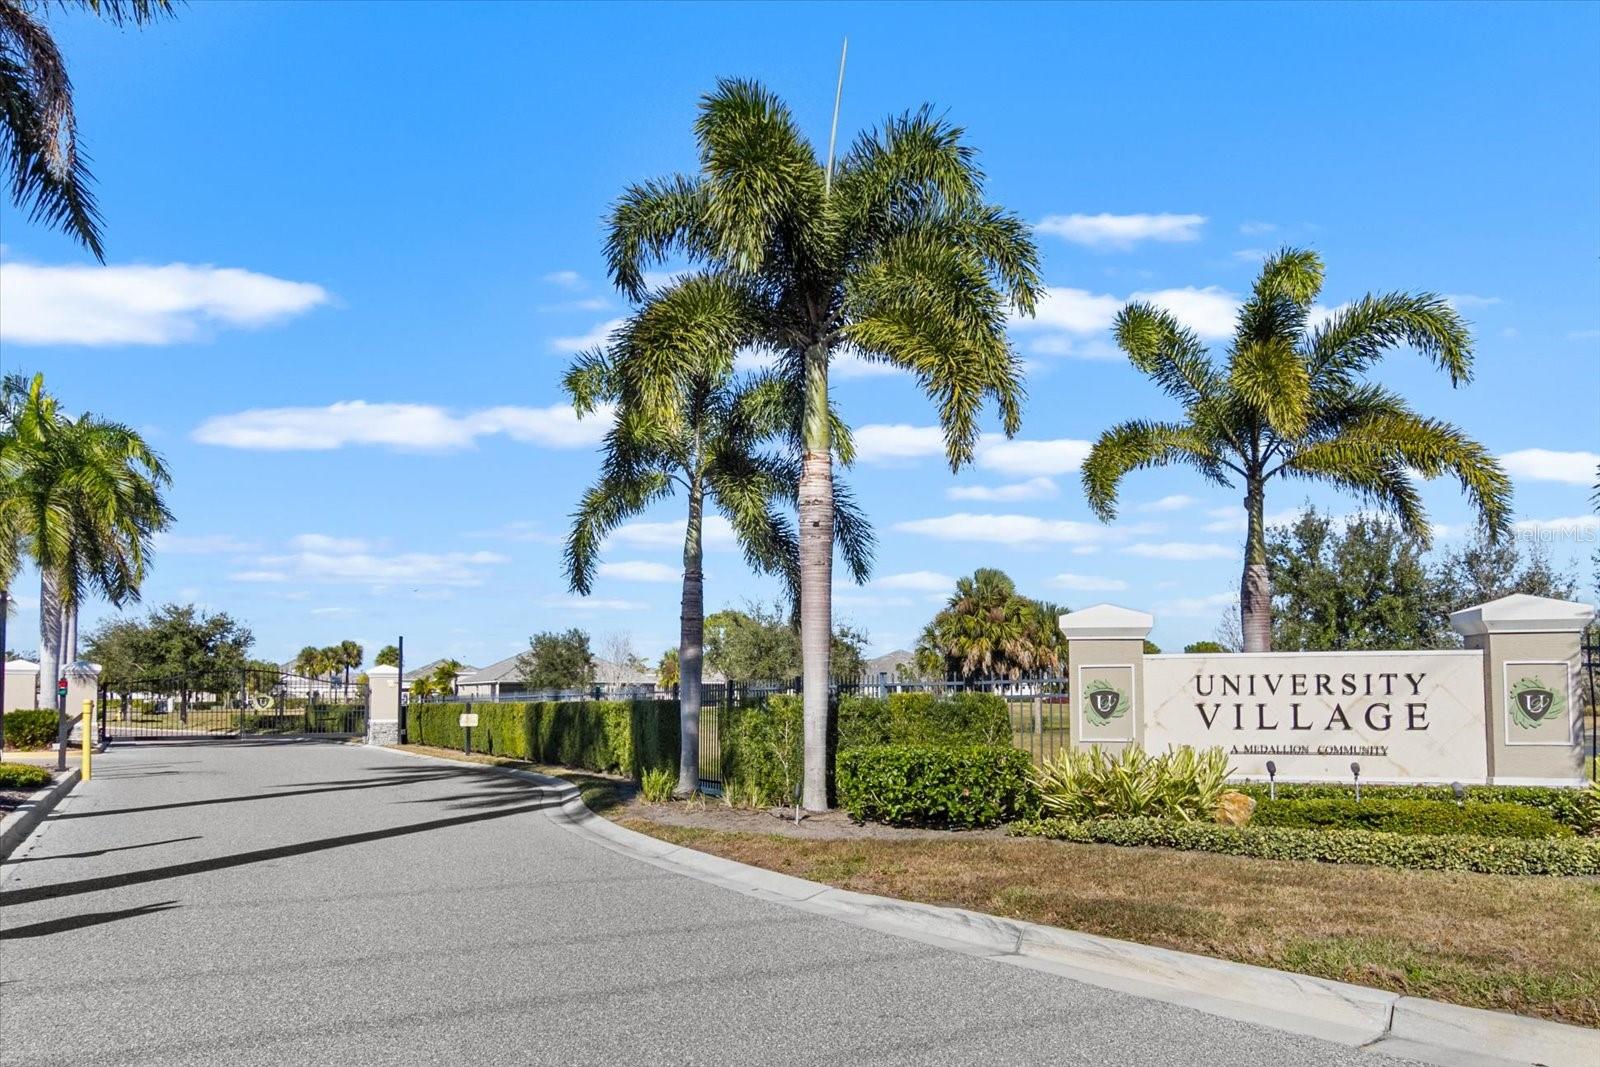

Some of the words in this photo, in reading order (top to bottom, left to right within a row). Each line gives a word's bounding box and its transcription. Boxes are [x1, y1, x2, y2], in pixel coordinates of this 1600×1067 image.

[1196, 673, 1427, 696] UNIVERSITY
[1195, 702, 1430, 731] VILLAGE
[1230, 745, 1238, 755] A
[1243, 745, 1310, 755] MEDALLION
[1317, 745, 1389, 756] COMMUNITY
